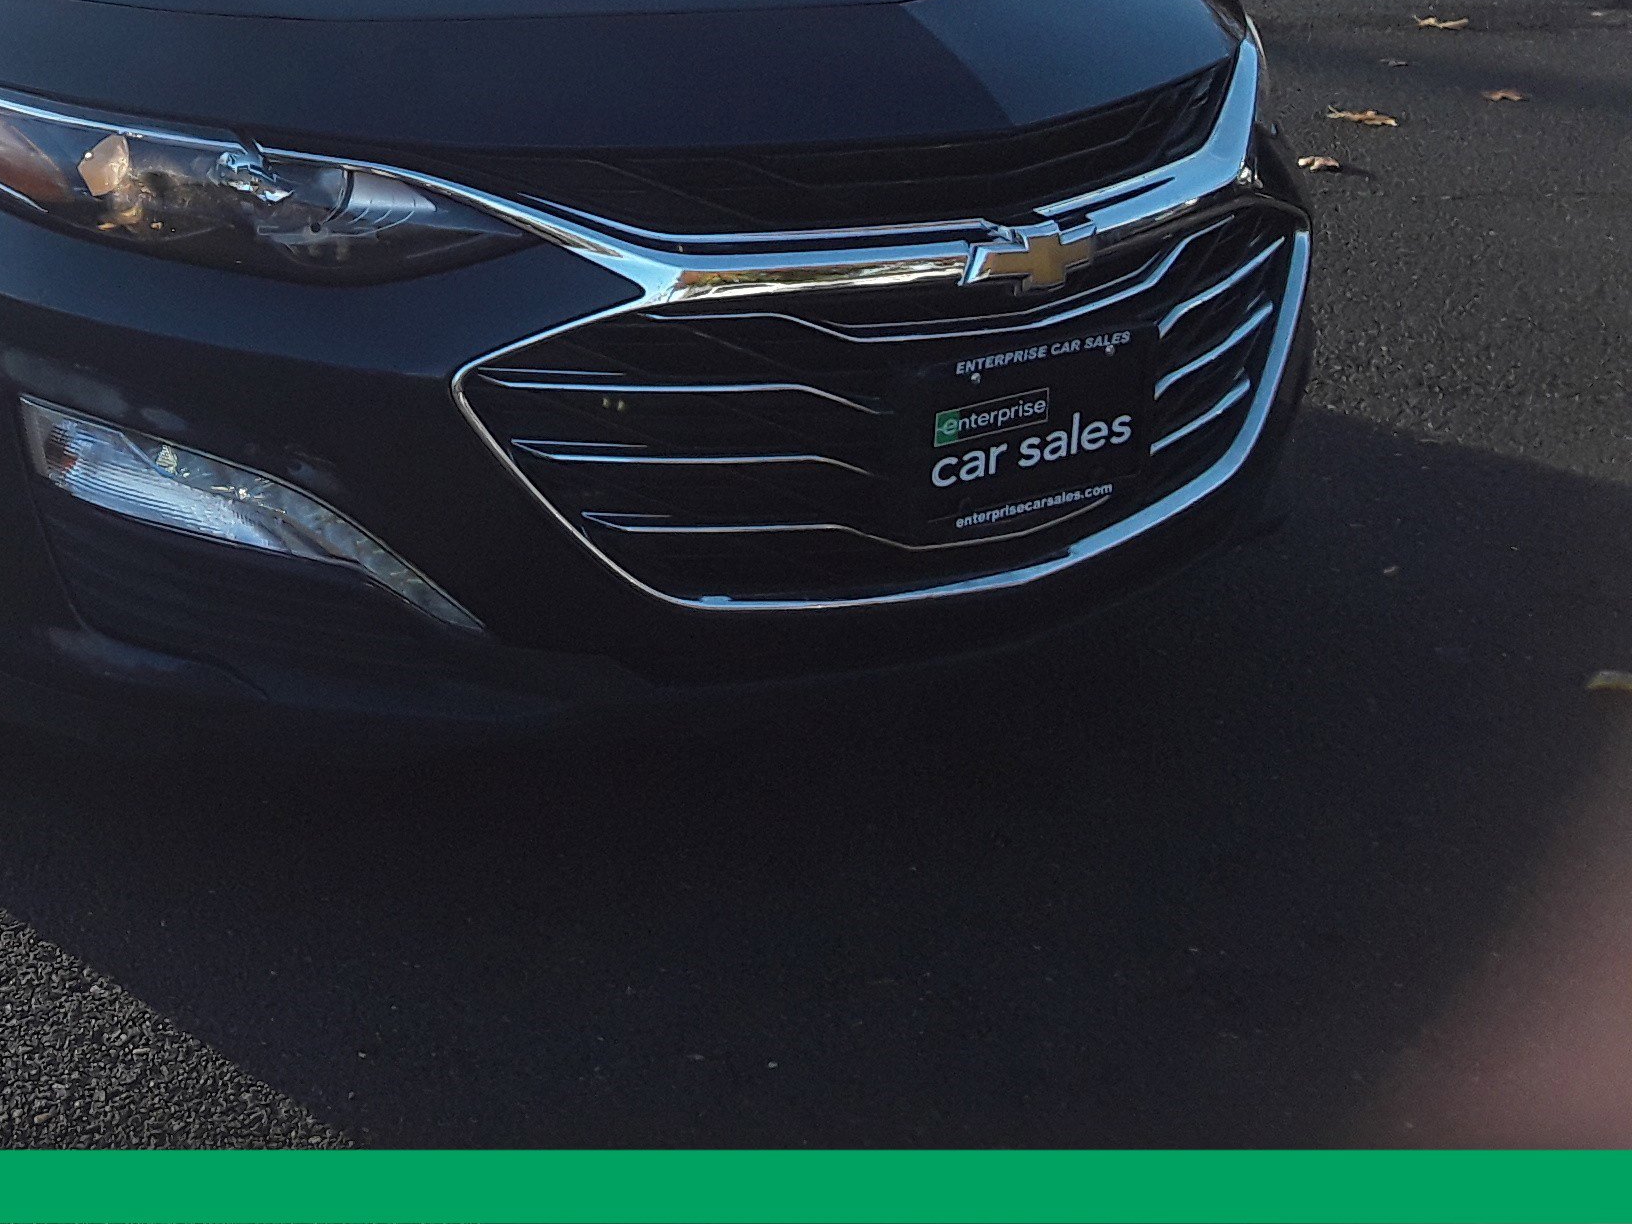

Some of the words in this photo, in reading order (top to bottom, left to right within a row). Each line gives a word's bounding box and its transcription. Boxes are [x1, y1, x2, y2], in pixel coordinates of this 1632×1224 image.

[955, 345, 1048, 375] ENTERPRISE
[1051, 338, 1081, 356] CAR
[1084, 331, 1131, 349] SALES
[938, 399, 1047, 436] enterprise
[931, 442, 1009, 487] car
[1018, 412, 1133, 467] sales
[955, 482, 1114, 528] enterprisecarsales.com
